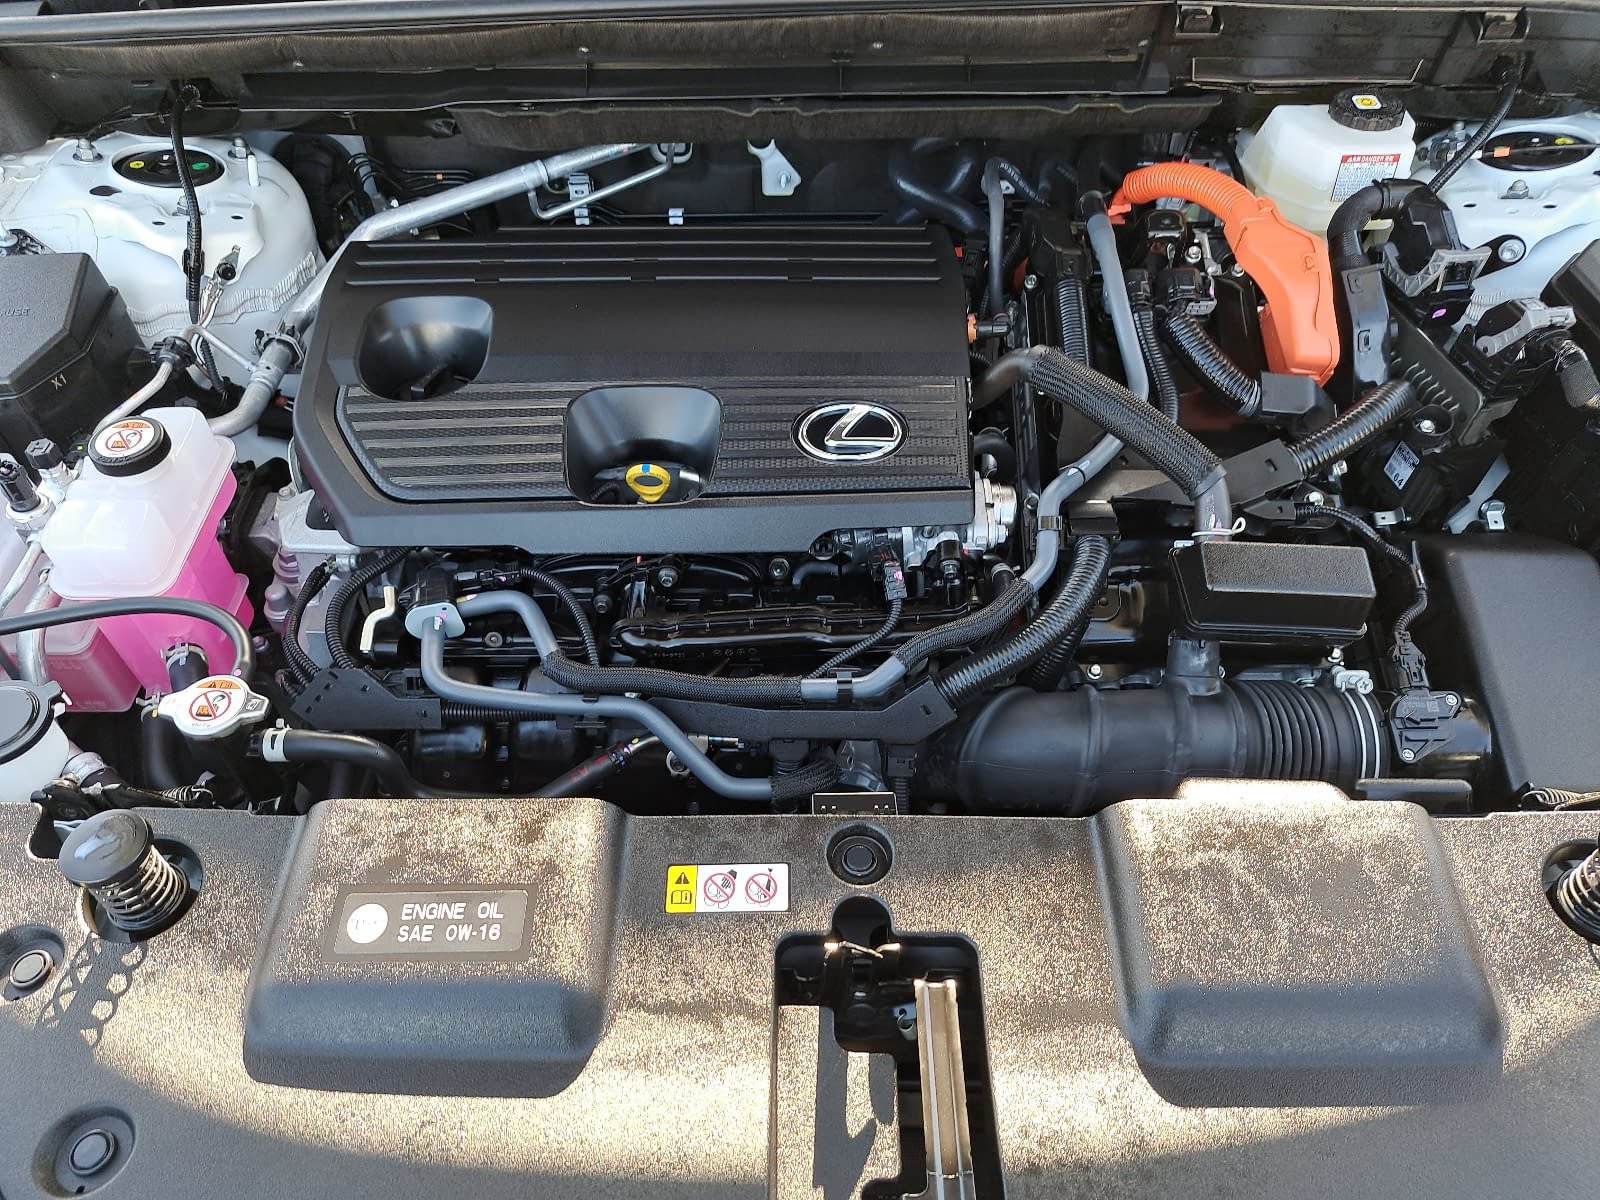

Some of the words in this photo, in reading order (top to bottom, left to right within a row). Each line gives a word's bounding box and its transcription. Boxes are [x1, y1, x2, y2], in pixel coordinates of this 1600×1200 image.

[51, 373, 67, 390] X1
[401, 902, 467, 921] ENGINE
[477, 901, 504, 919] OIL
[397, 924, 435, 942] SAE
